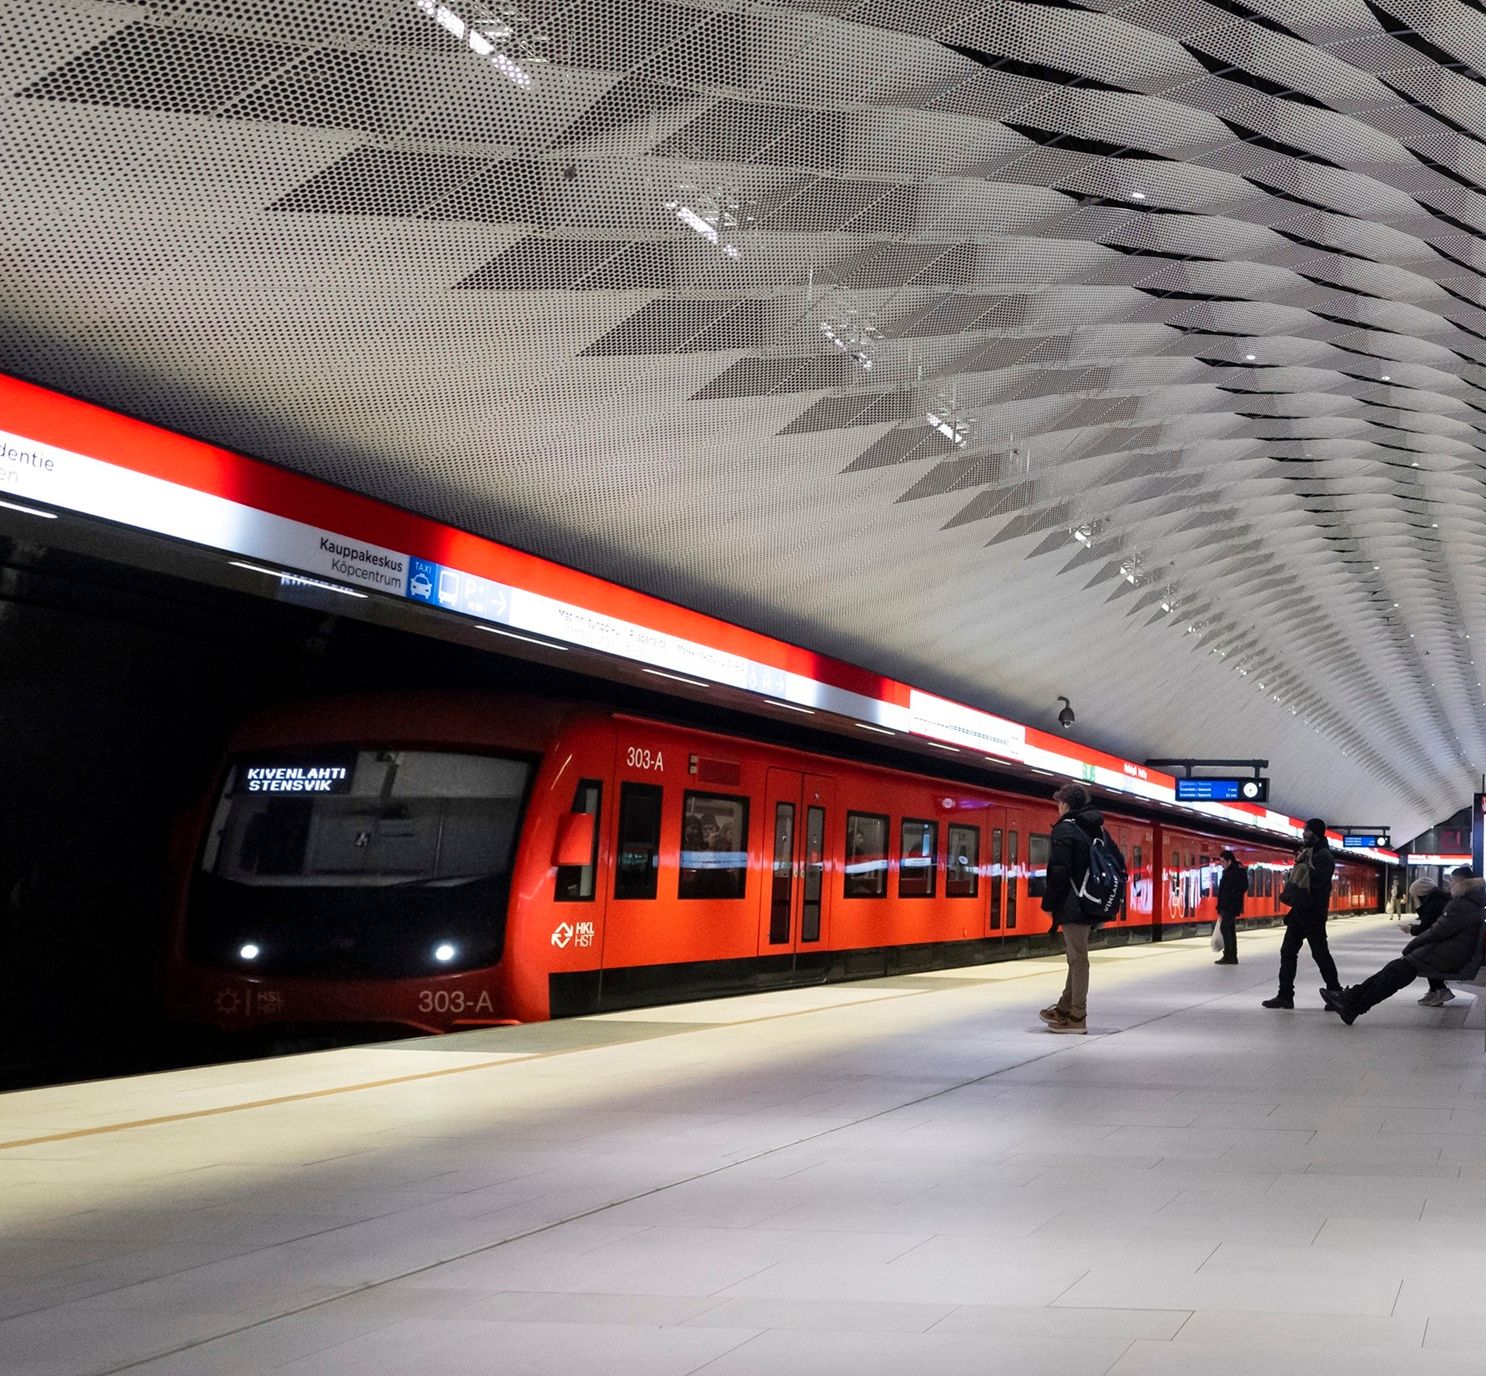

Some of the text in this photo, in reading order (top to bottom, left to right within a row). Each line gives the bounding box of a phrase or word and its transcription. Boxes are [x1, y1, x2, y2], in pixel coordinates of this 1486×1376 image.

[320, 537, 403, 573] Kauppakeskus
[331, 557, 401, 589] Köpcentrum
[415, 561, 432, 574] TAXI
[627, 746, 664, 772] 303-A
[247, 768, 346, 779] KIVENLAHTI
[248, 780, 332, 791] STENSVIK
[575, 921, 595, 934] HKL
[574, 934, 595, 947] HST
[257, 991, 284, 1002] HSL
[419, 990, 494, 1013] 303-A
